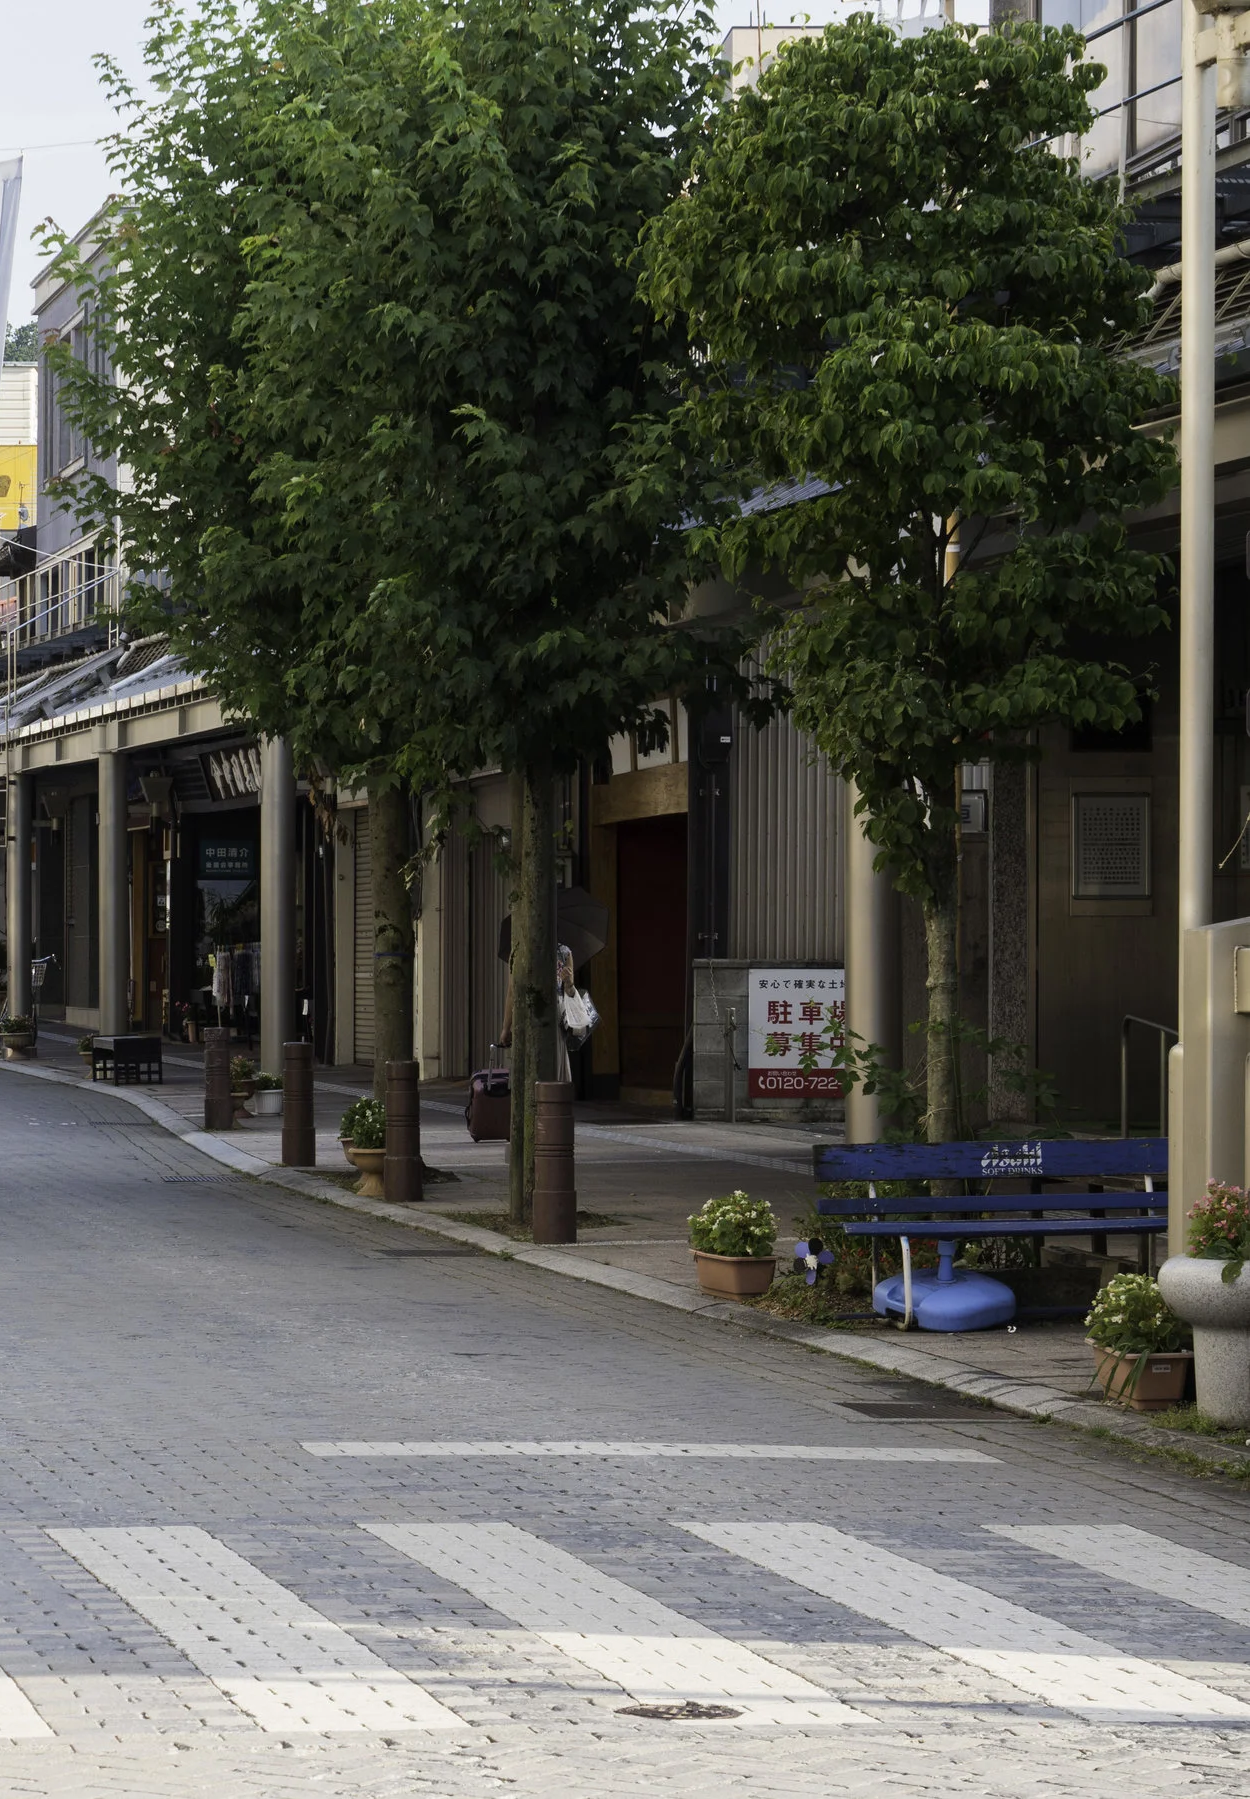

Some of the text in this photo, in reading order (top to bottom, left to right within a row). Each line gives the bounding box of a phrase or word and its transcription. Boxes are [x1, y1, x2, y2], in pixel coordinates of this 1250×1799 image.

[205, 847, 249, 858] 中田清介
[982, 1167, 1006, 1176] SOFT
